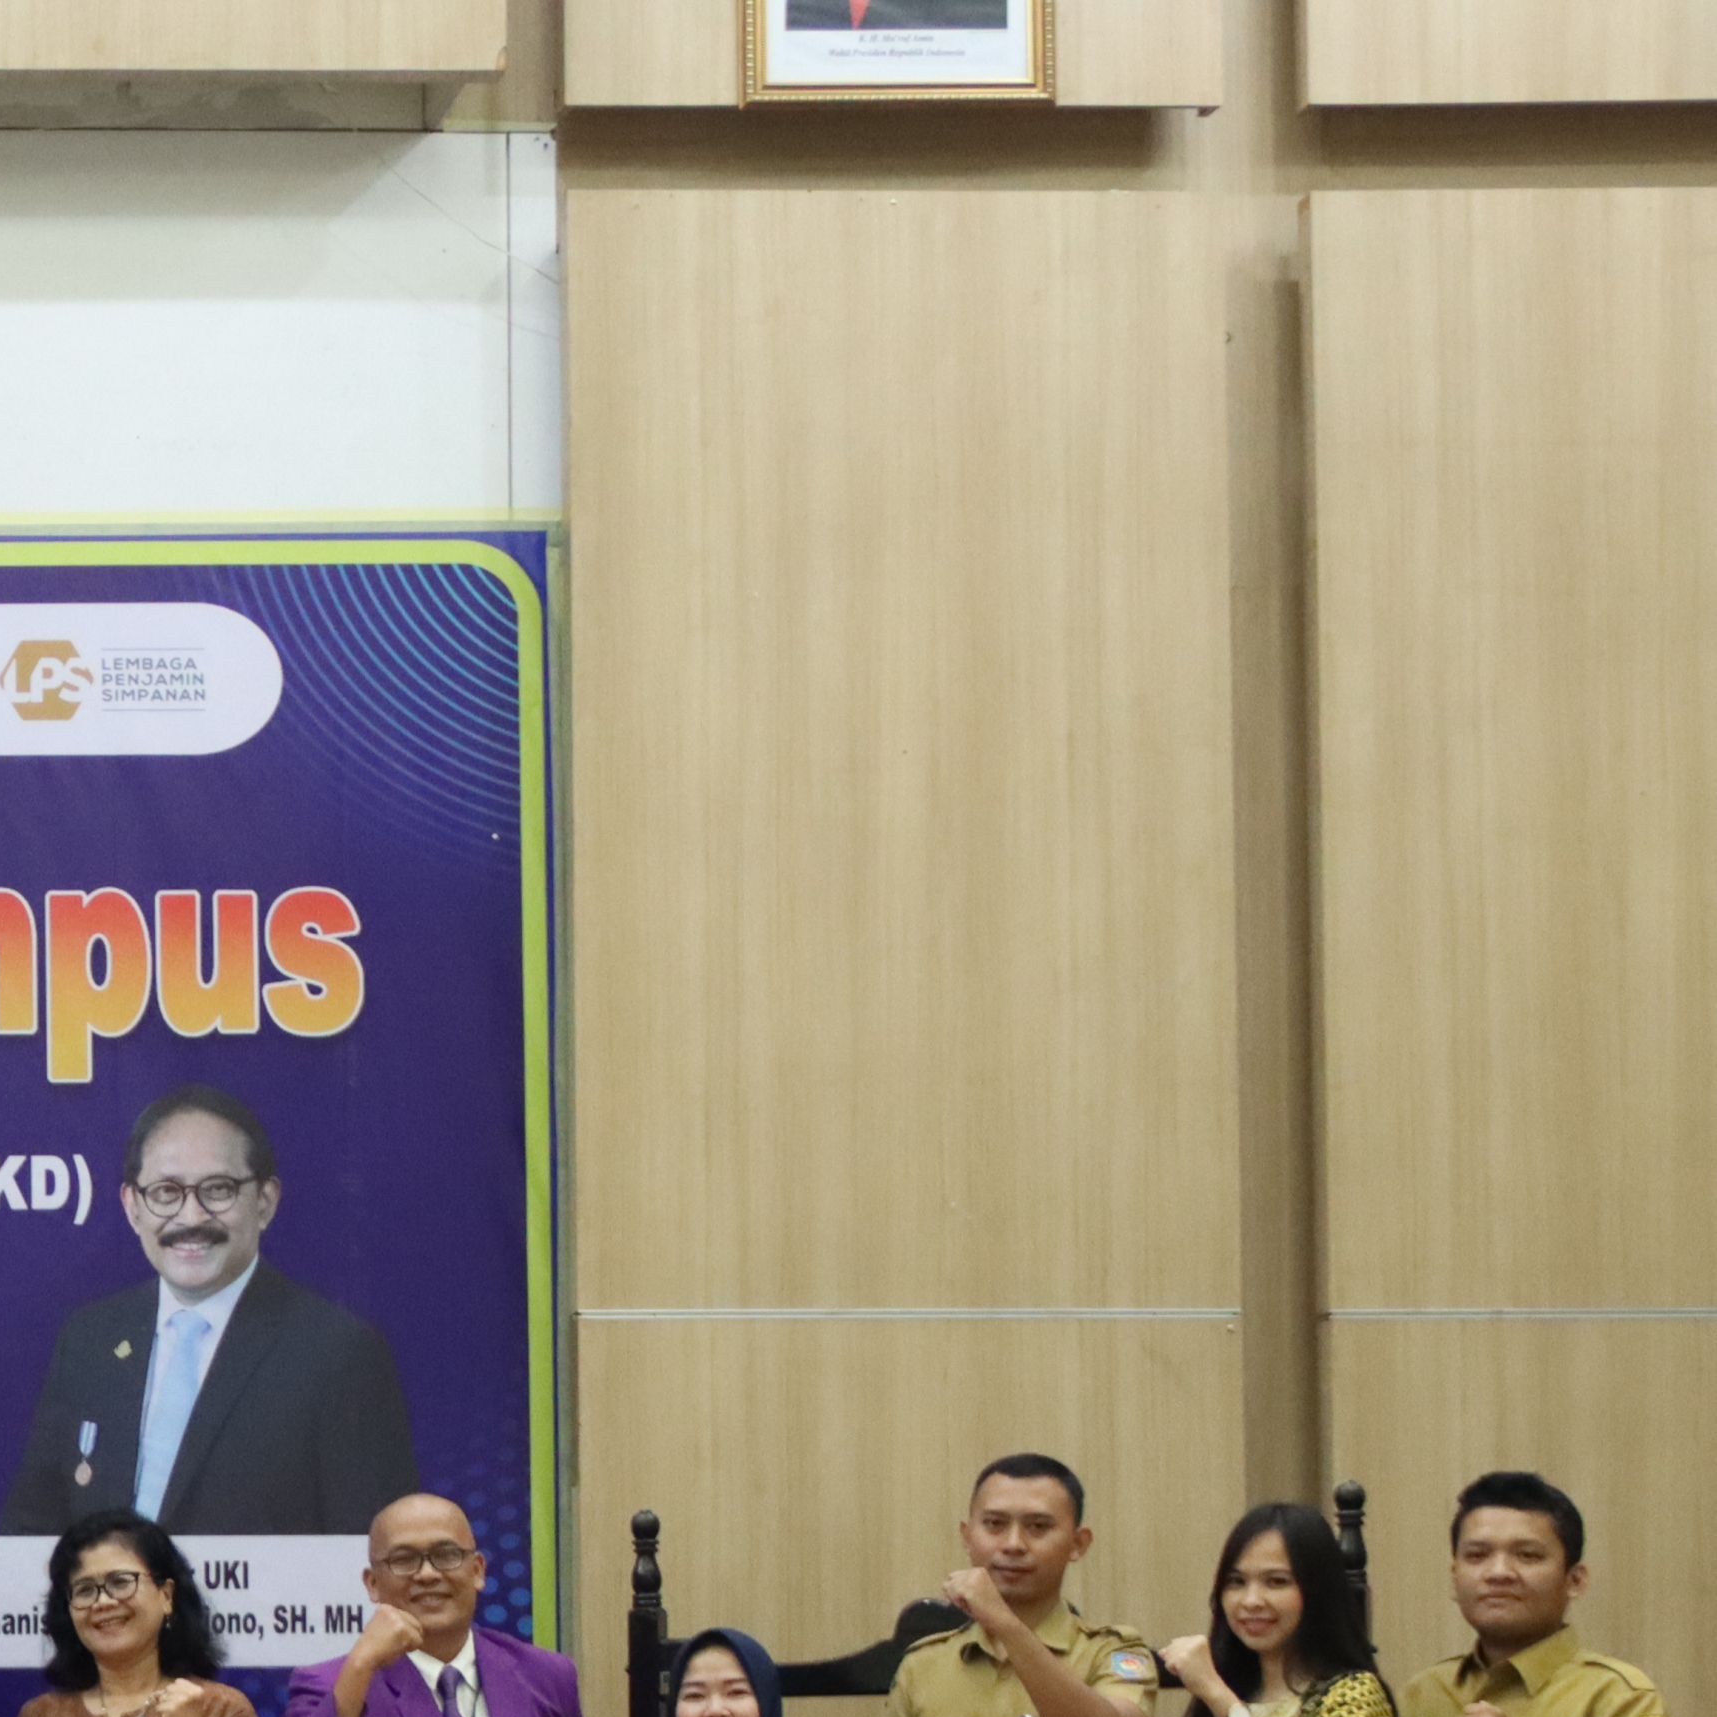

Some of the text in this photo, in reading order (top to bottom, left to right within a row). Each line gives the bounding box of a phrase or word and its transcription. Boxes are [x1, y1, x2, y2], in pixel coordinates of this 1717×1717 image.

[101, 657, 197, 671] LEMBAGA
[11, 656, 93, 704] LPS
[101, 673, 205, 687] PENJAMIN
[101, 688, 207, 703] SIMPANAN
[203, 1560, 249, 1590] UKI
[273, 1604, 316, 1634] SH.
[324, 1604, 364, 1634] MH
